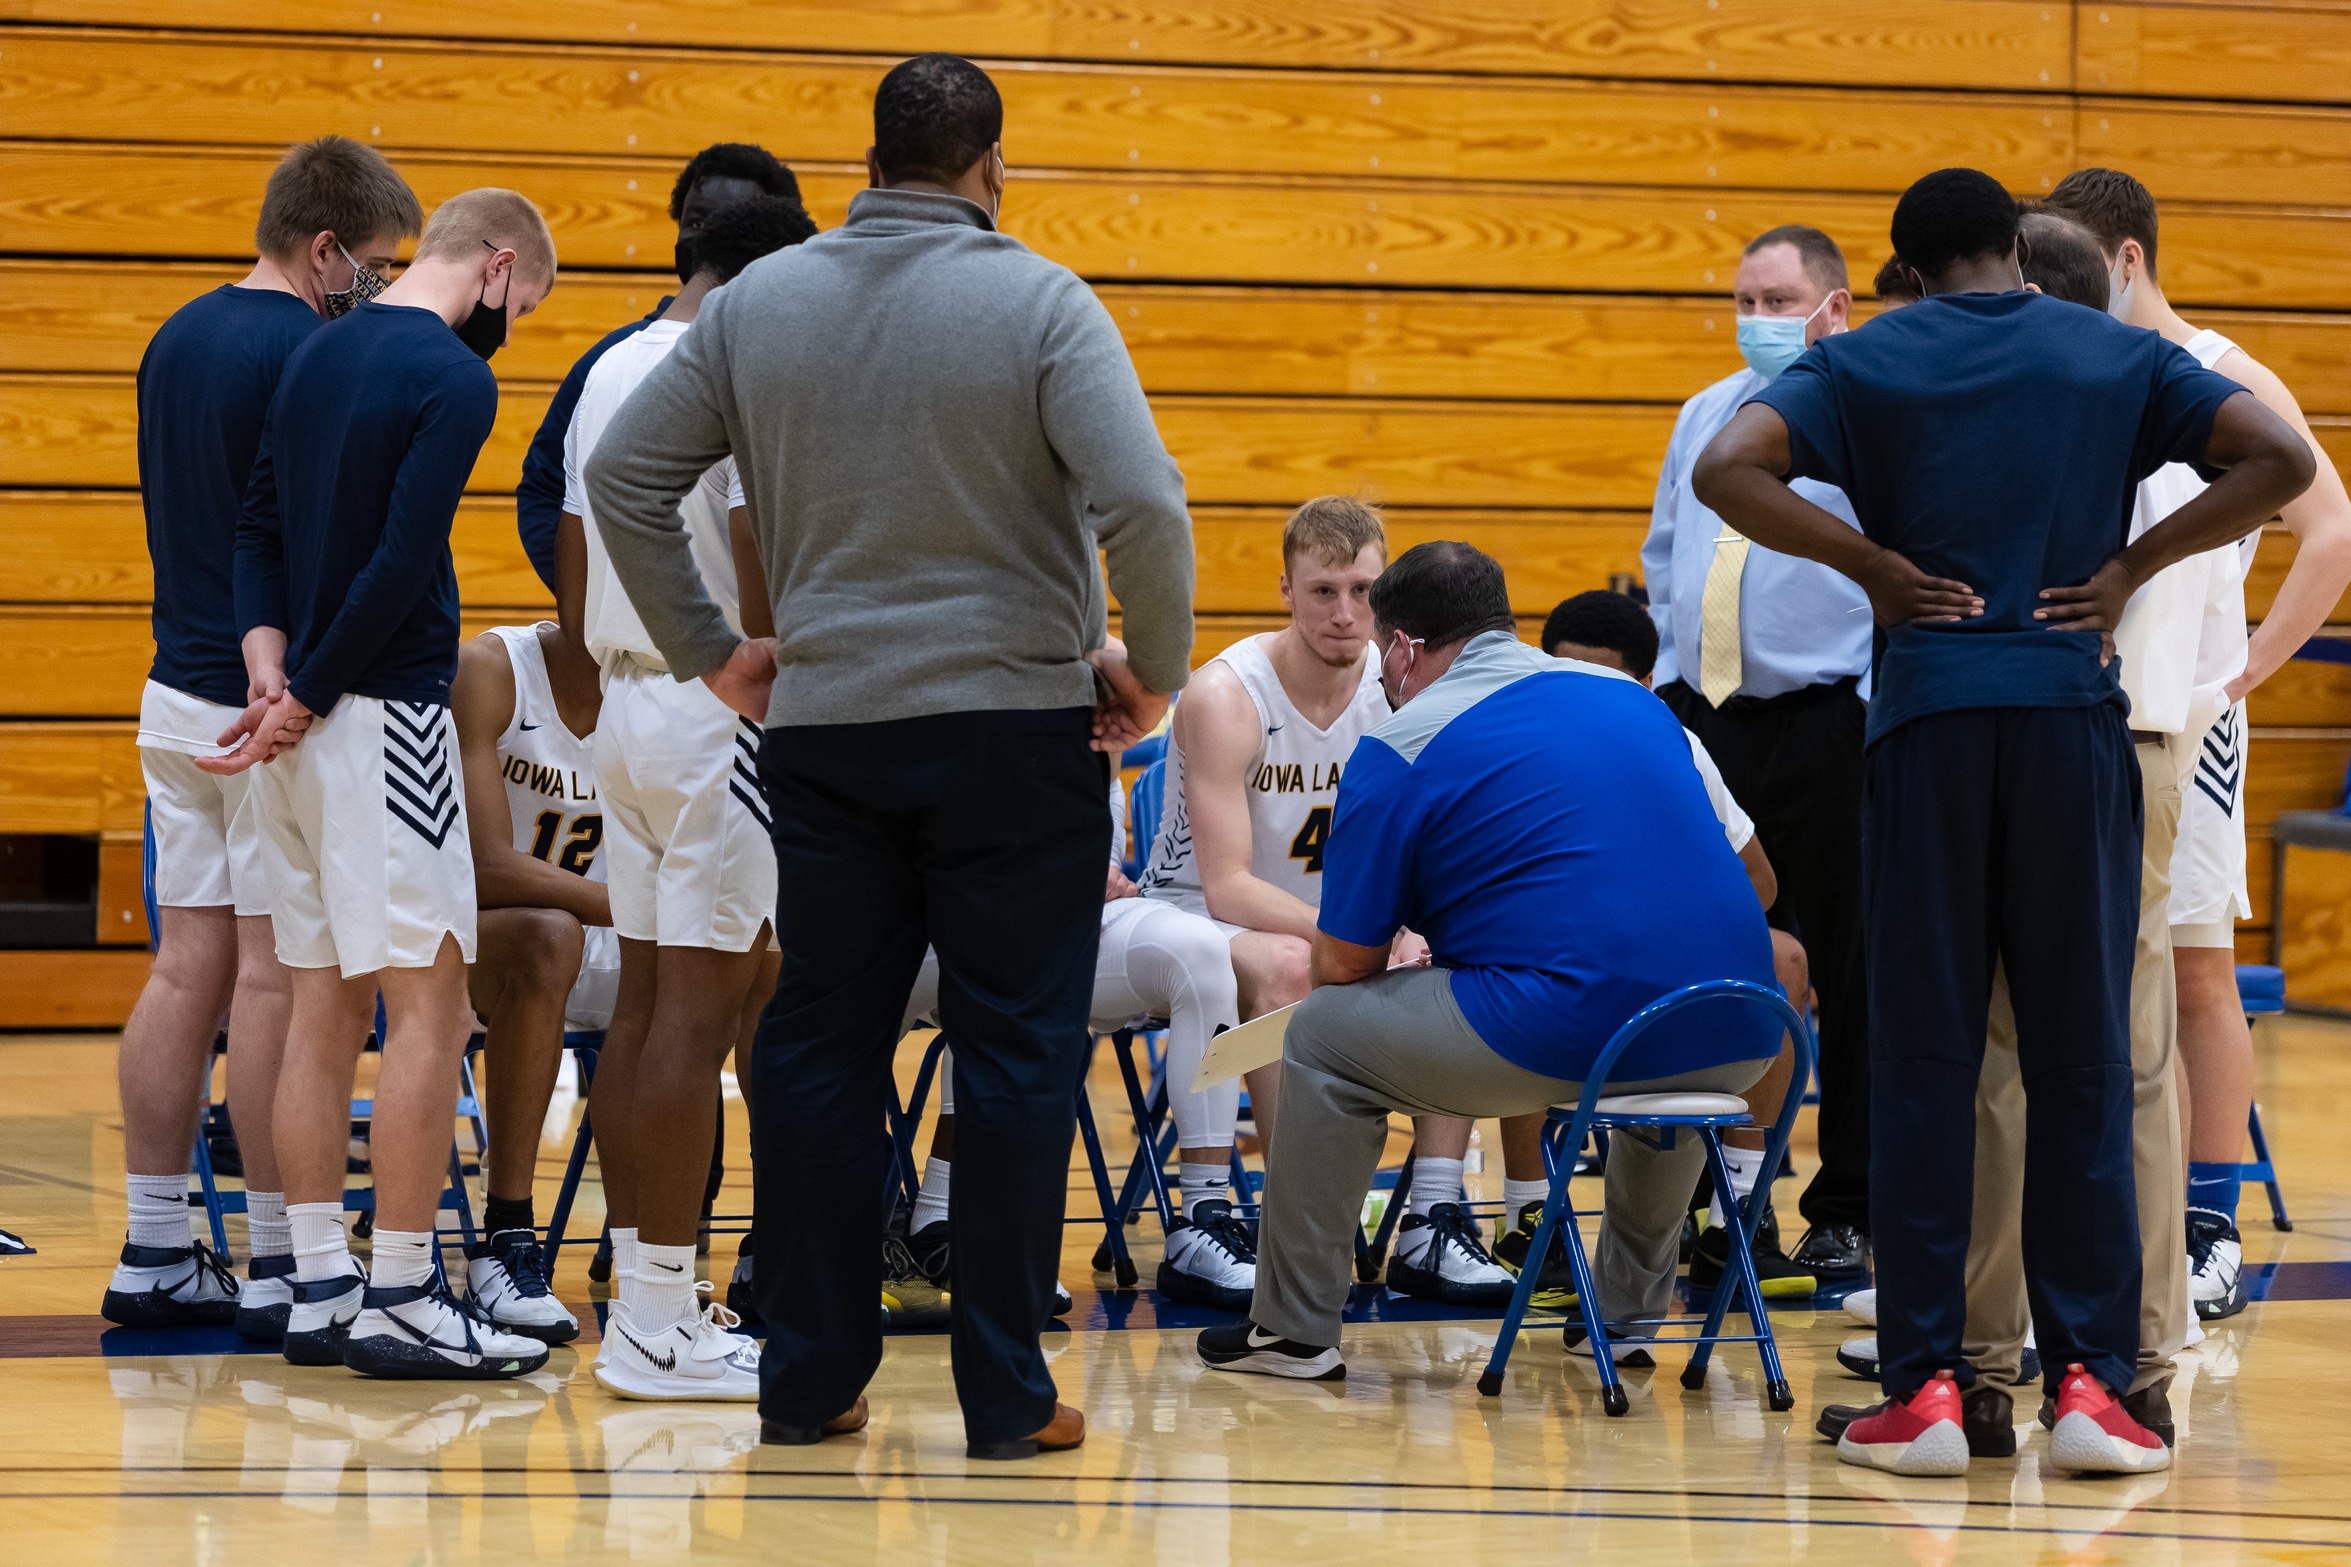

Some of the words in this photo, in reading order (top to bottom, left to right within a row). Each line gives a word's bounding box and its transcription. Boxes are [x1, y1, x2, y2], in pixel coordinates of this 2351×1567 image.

[501, 754, 564, 799] IOWA
[1251, 762, 1305, 793] IOWA
[1312, 762, 1347, 792] LA
[528, 808, 604, 877] 12
[1287, 805, 1334, 875] 4
